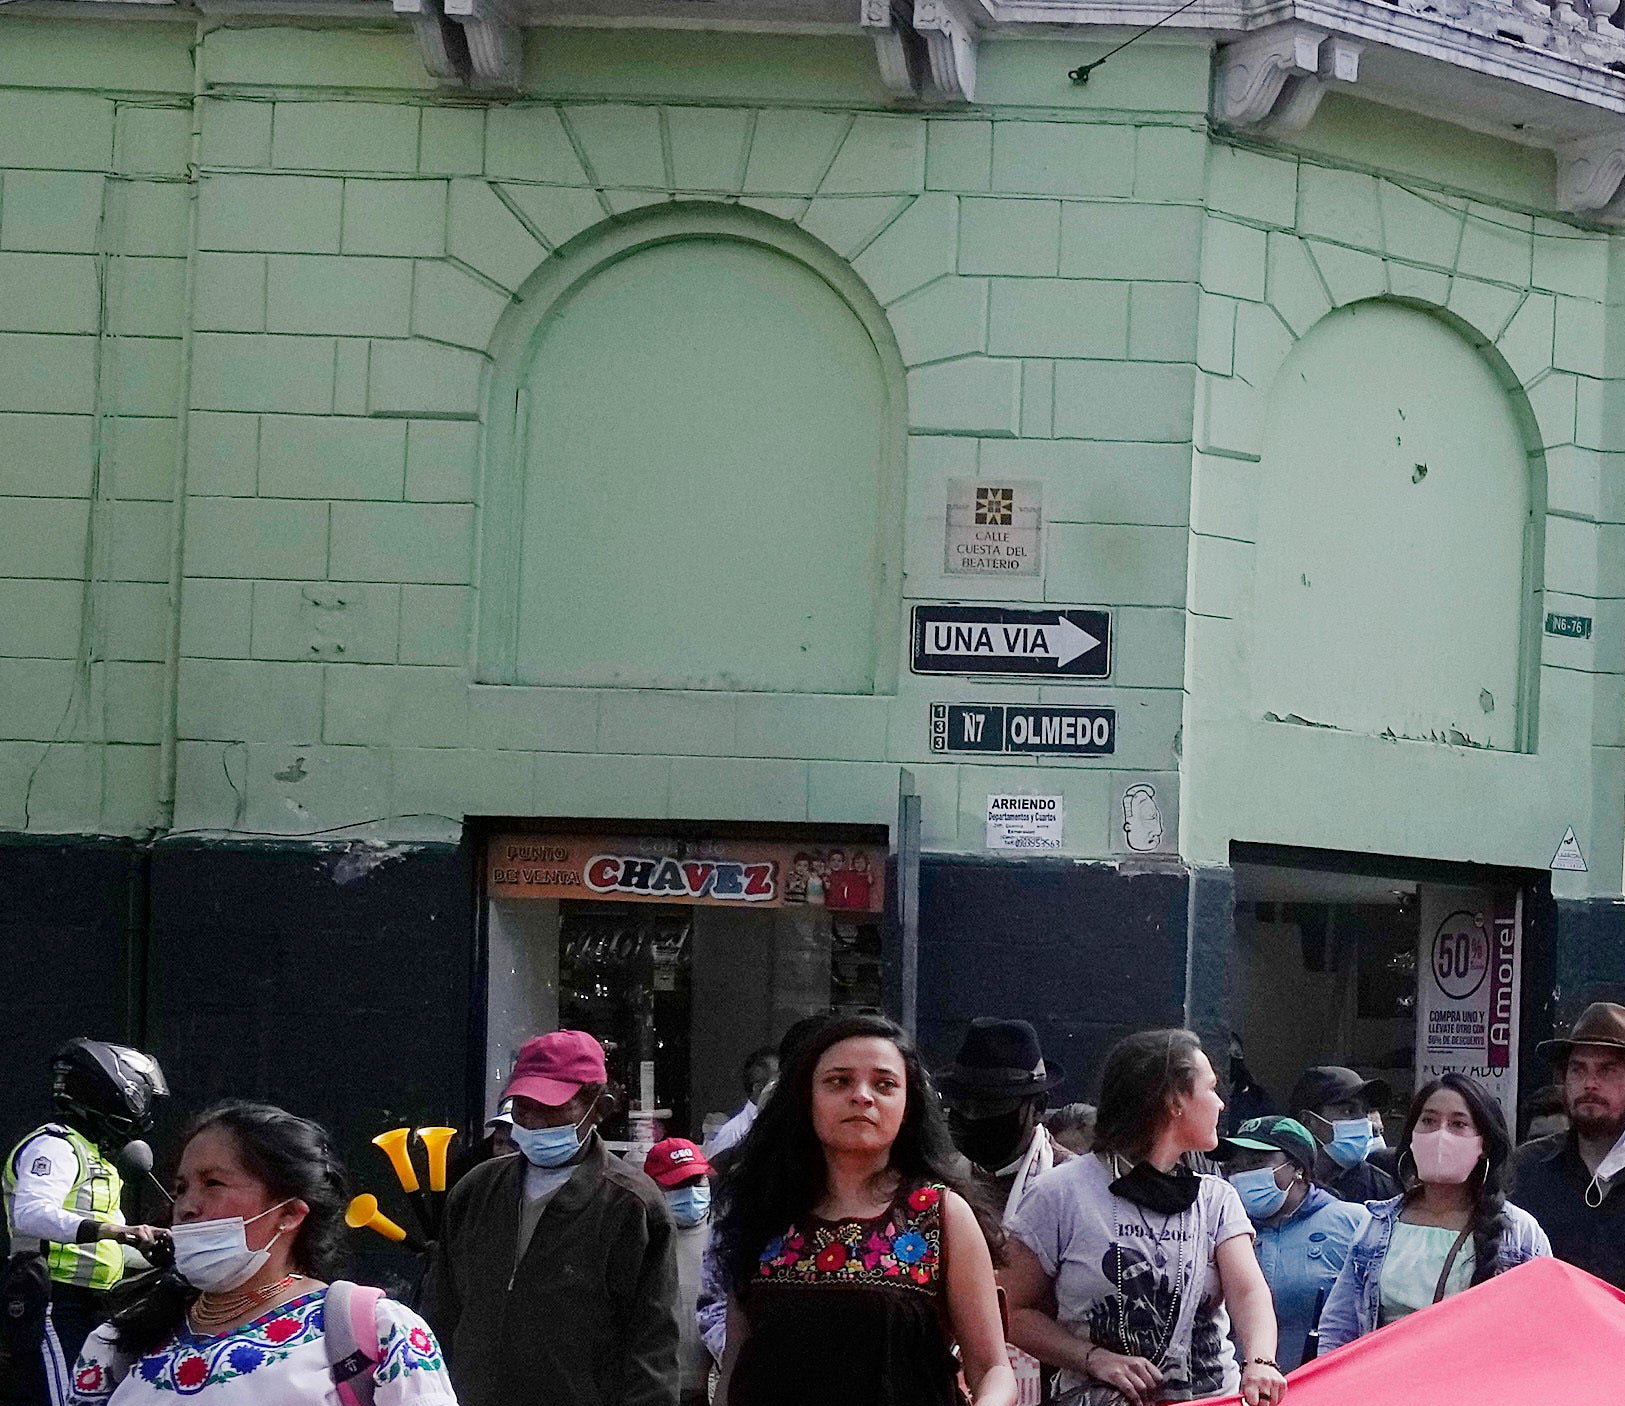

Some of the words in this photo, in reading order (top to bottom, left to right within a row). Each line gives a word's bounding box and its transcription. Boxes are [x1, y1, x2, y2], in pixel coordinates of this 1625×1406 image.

[975, 531, 1010, 543] CALLE
[957, 544, 1001, 556] CUESTA
[1006, 546, 1027, 557] DEL
[962, 558, 1019, 570] BEATERIO
[934, 625, 994, 653] UNA
[1003, 627, 1050, 654] VIA
[962, 712, 986, 742] N7
[1010, 715, 1070, 746] OLMEDO
[992, 799, 1056, 810] ARRIENDO
[505, 846, 569, 863] PUNTO
[493, 868, 520, 885] DE
[523, 868, 582, 886] VENTA
[1490, 918, 1516, 1046] Amorel
[1429, 1010, 1461, 1023] COMPRA
[1462, 1011, 1478, 1023] UNO
[1480, 1011, 1485, 1024] Y
